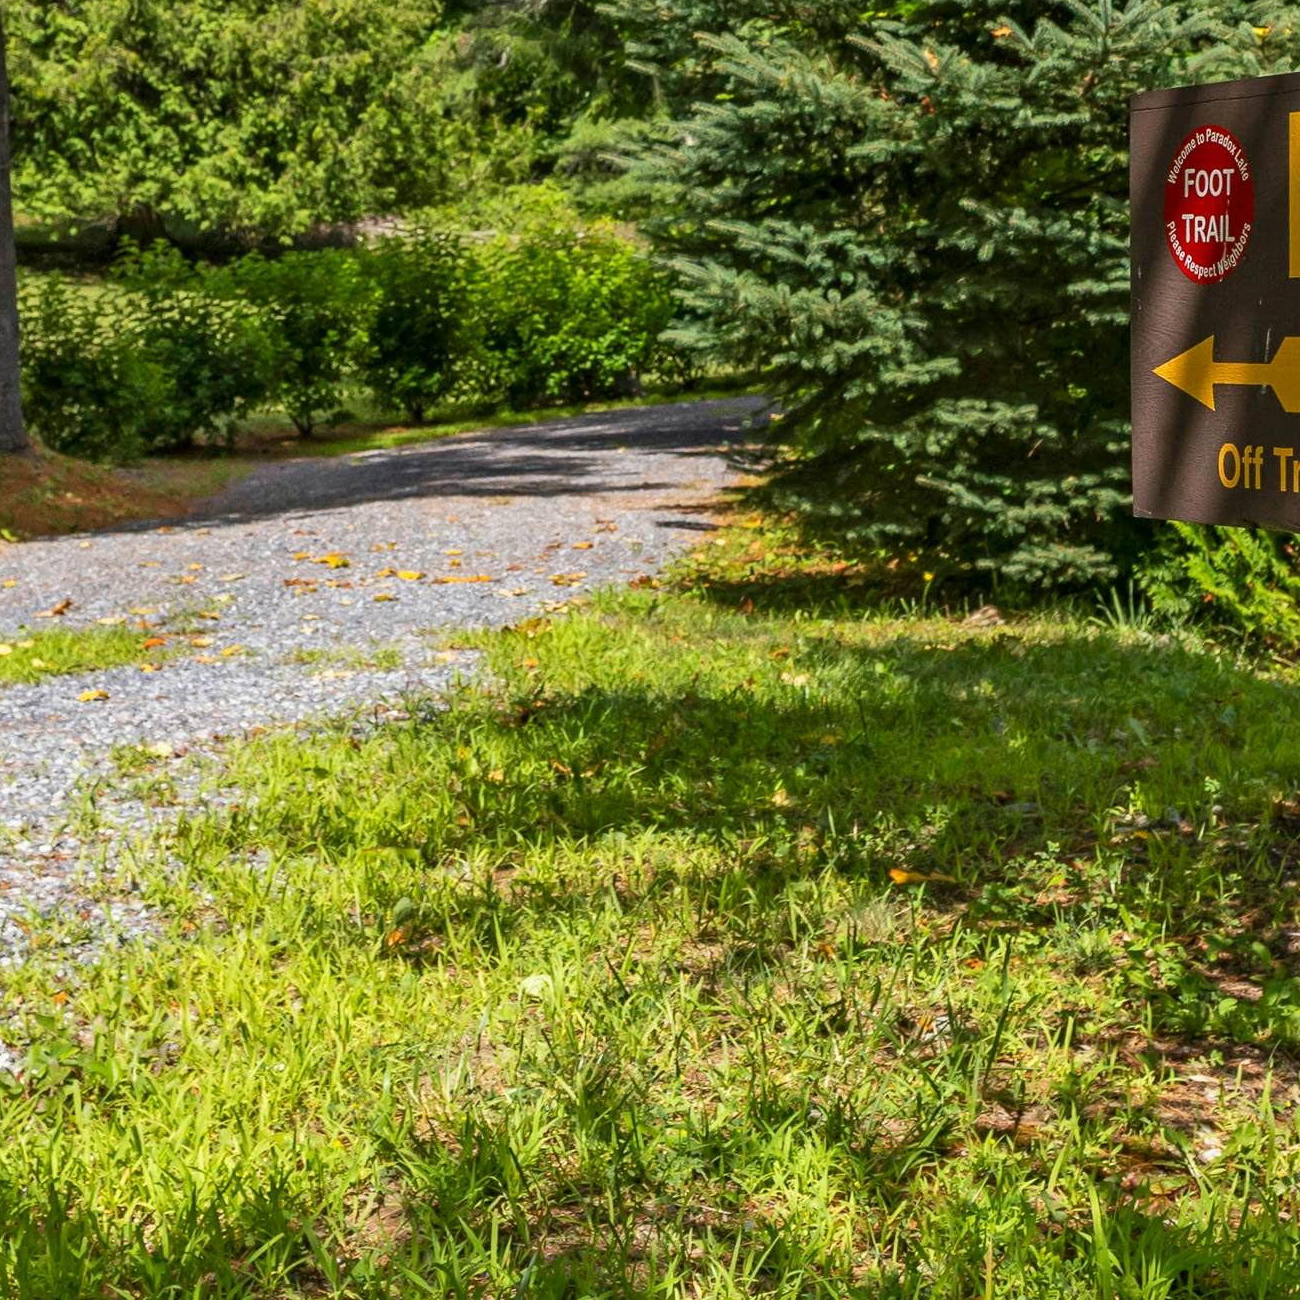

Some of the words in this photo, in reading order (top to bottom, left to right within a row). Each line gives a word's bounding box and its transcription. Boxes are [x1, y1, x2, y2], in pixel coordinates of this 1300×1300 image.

[1167, 138, 1197, 185] Welcome
[1195, 132, 1205, 146] to
[1206, 128, 1237, 156] Paradox
[1234, 148, 1249, 182] Lake
[1184, 168, 1235, 198] FOOT
[1166, 220, 1186, 261] Please
[1184, 254, 1217, 280] Respect
[1217, 222, 1251, 276] Neighbors
[1181, 213, 1236, 244] TRAIL
[1216, 443, 1264, 490] Off
